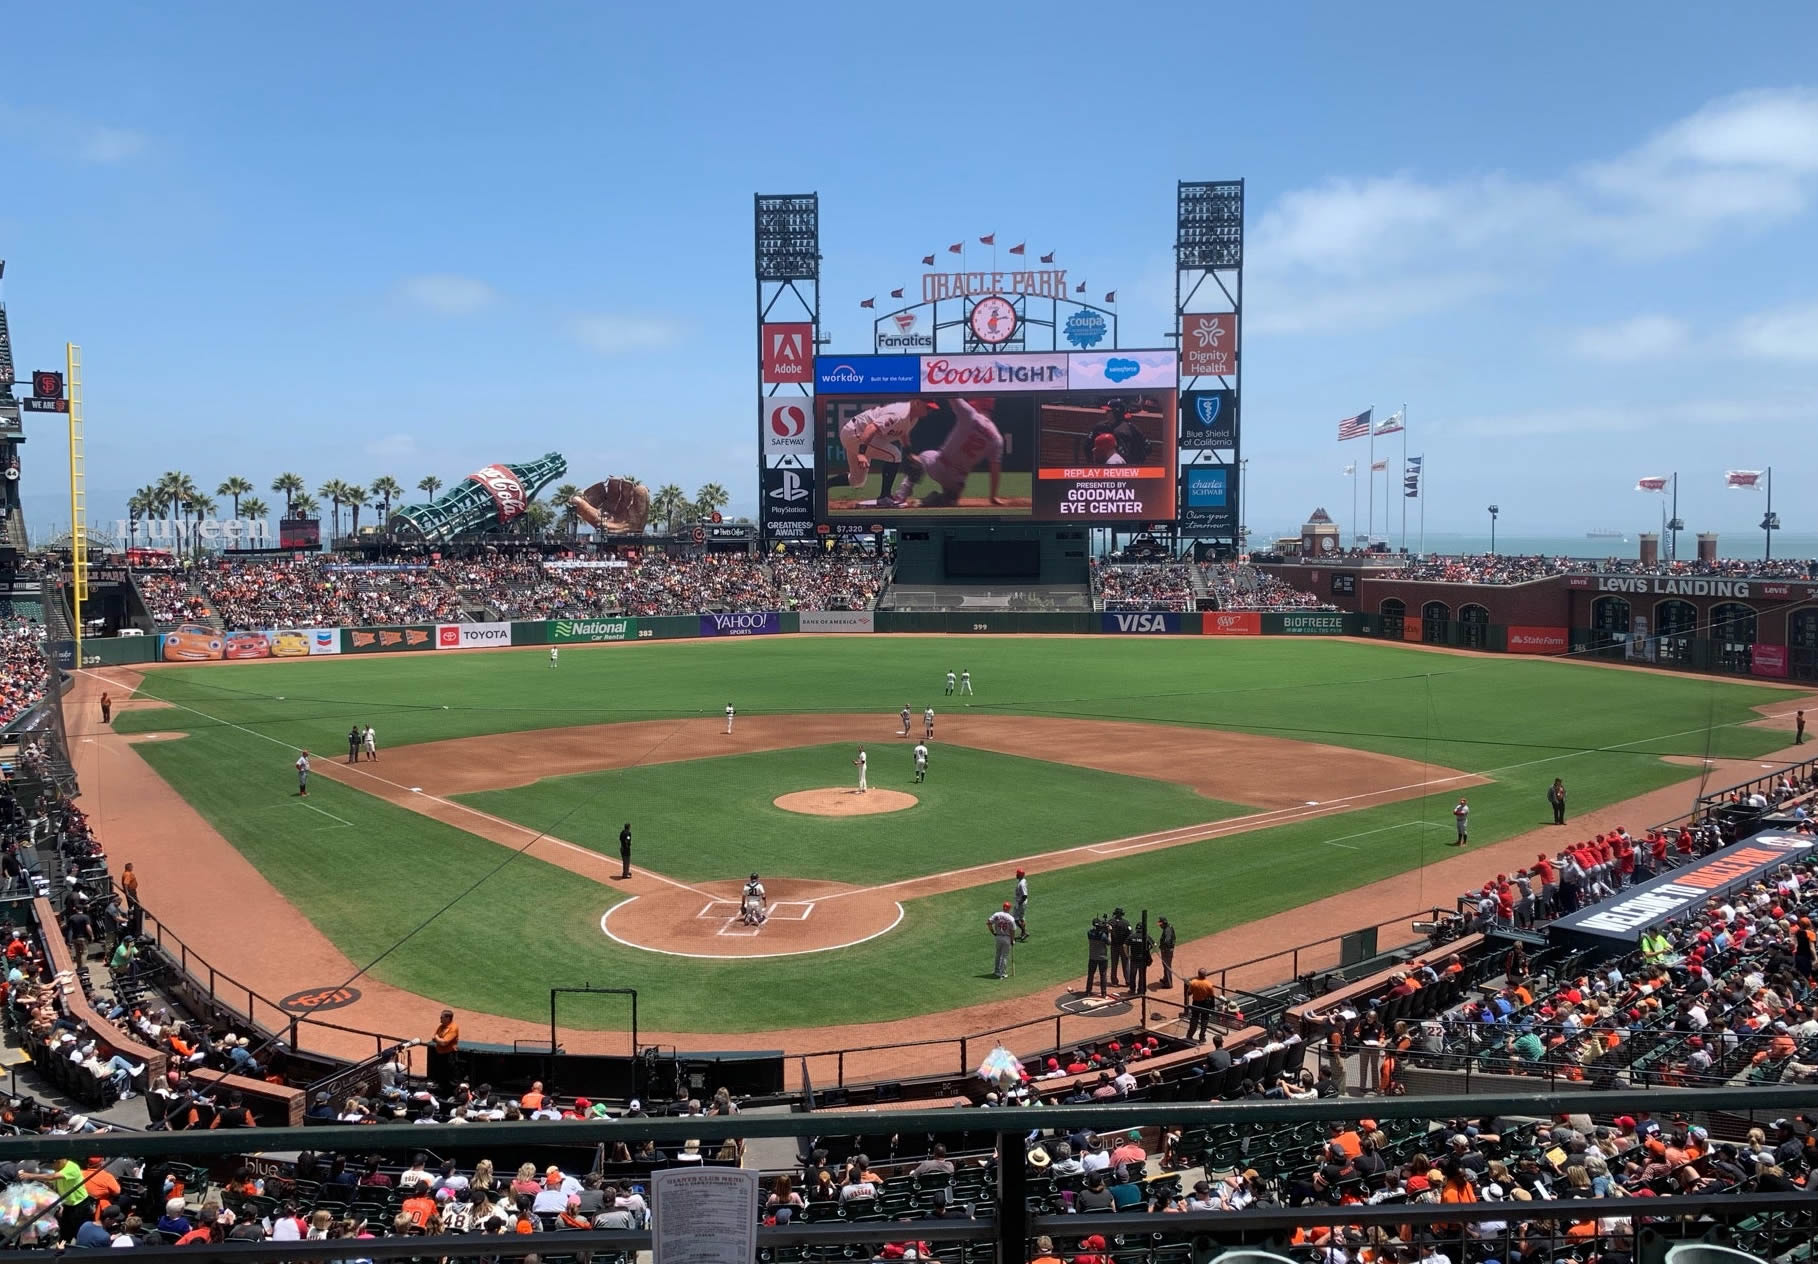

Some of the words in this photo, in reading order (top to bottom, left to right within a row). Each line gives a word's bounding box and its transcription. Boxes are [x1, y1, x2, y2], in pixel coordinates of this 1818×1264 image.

[923, 271, 1004, 303] ORACLE
[1012, 270, 1068, 300] PARK
[1070, 316, 1103, 328] coupa
[879, 334, 932, 347] Fanatics
[1189, 350, 1228, 363] Dignity
[774, 363, 802, 374] Adobe
[927, 360, 995, 385] Coors
[998, 365, 1056, 382] LIGHT
[1191, 363, 1226, 374] Health
[822, 372, 865, 384] workday
[32, 400, 43, 409] WE
[43, 401, 55, 410] ARE
[1186, 430, 1204, 438] Blue
[1205, 430, 1229, 438] Shield
[772, 438, 805, 446] SAFEWAY
[1184, 438, 1193, 446] of
[1194, 438, 1233, 446] California
[1064, 468, 1100, 478] REPLAY
[1103, 468, 1139, 477] REVIEW
[1192, 480, 1223, 489] charles
[1068, 489, 1135, 501] GOODMAN
[772, 506, 808, 514] PlayStation
[1060, 502, 1085, 514] EYE
[1090, 502, 1142, 513] CENTER
[116, 519, 271, 538] nuveen
[767, 521, 812, 529] GREATNESS
[775, 528, 804, 536] AWAITS
[1654, 579, 1749, 598] LANDING
[572, 620, 627, 635] National
[713, 613, 767, 630] YAHOO!
[1113, 614, 1166, 631] VISA
[1283, 618, 1343, 627] BIOFREEZE
[464, 630, 508, 640] TOYOTA
[1576, 892, 1689, 932] WELCOME
[1651, 884, 1707, 898] TO
[444, 1214, 465, 1228] 48
